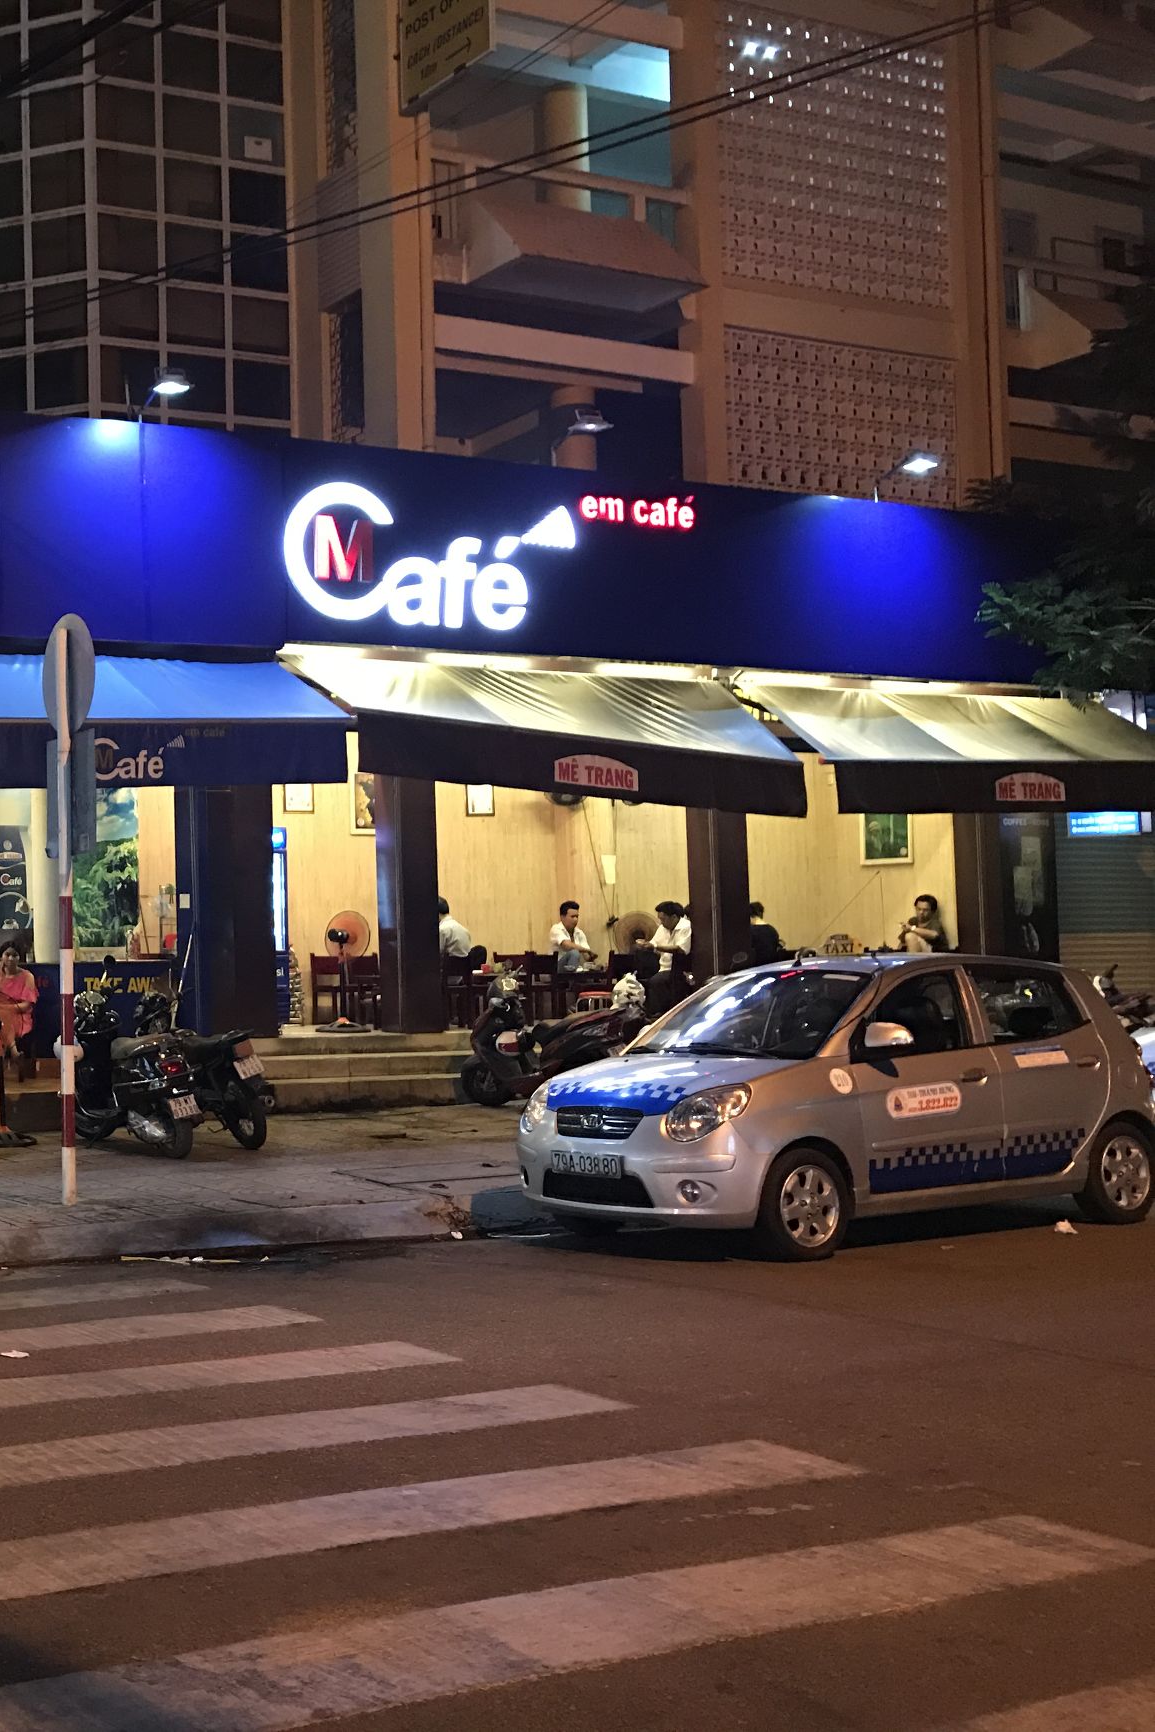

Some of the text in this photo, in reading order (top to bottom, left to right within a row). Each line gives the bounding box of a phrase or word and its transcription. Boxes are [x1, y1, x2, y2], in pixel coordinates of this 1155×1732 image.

[581, 494, 695, 530] em café
[284, 481, 529, 631] Café
[558, 757, 634, 789] MÊ TRANG
[998, 775, 1062, 800] MÊ TRANG
[823, 942, 854, 954] TAXI
[83, 976, 124, 994] TAKE
